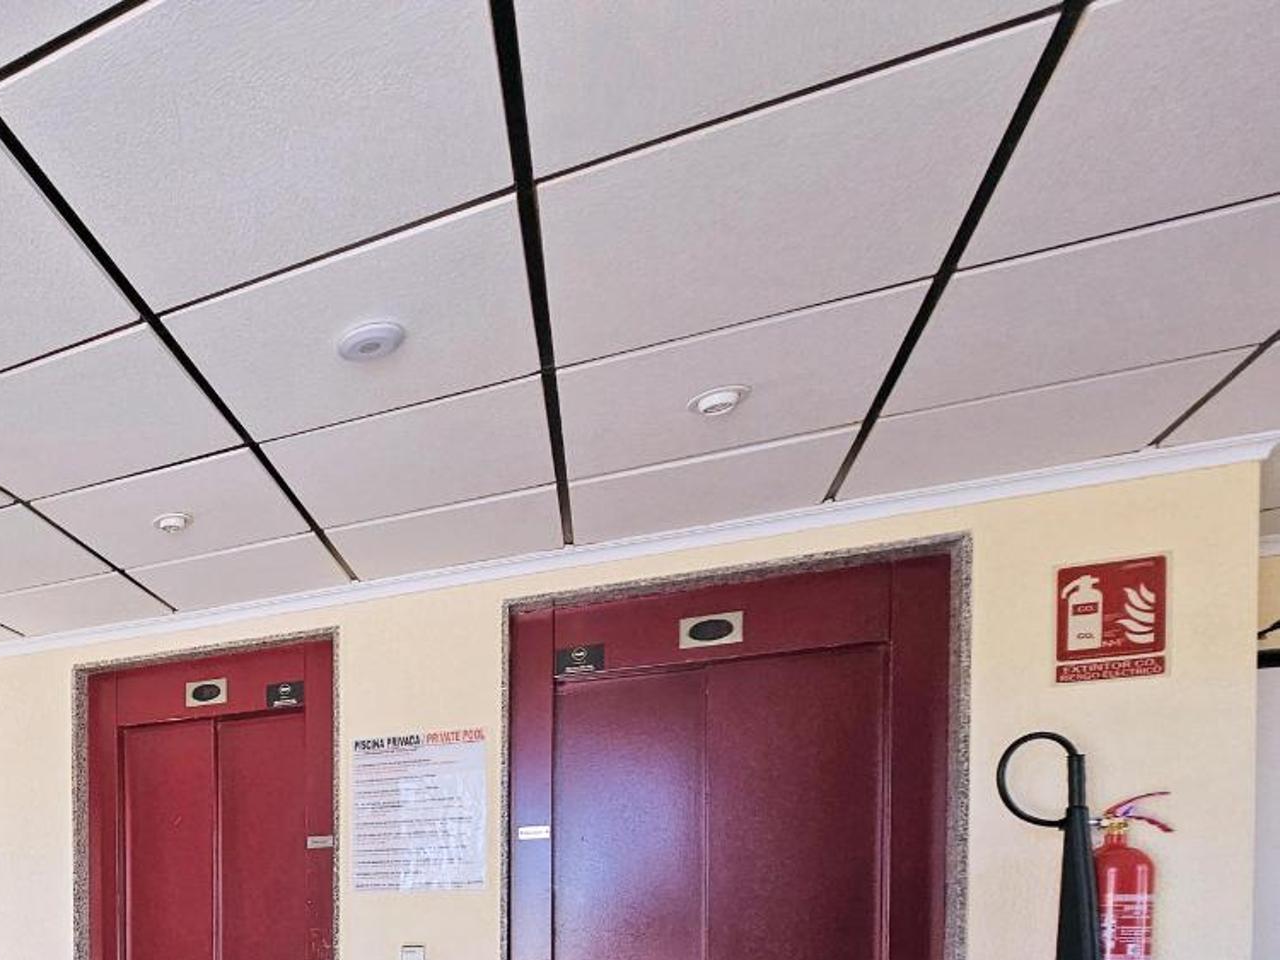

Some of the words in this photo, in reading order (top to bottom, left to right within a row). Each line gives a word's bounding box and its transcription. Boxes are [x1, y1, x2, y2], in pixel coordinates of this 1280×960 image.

[1062, 660, 1131, 674] EXTINTOR
[354, 739, 385, 751] PISCINA
[387, 734, 420, 749] PRIVADA
[426, 730, 460, 744] PRIVATE
[463, 727, 485, 741] POOL
